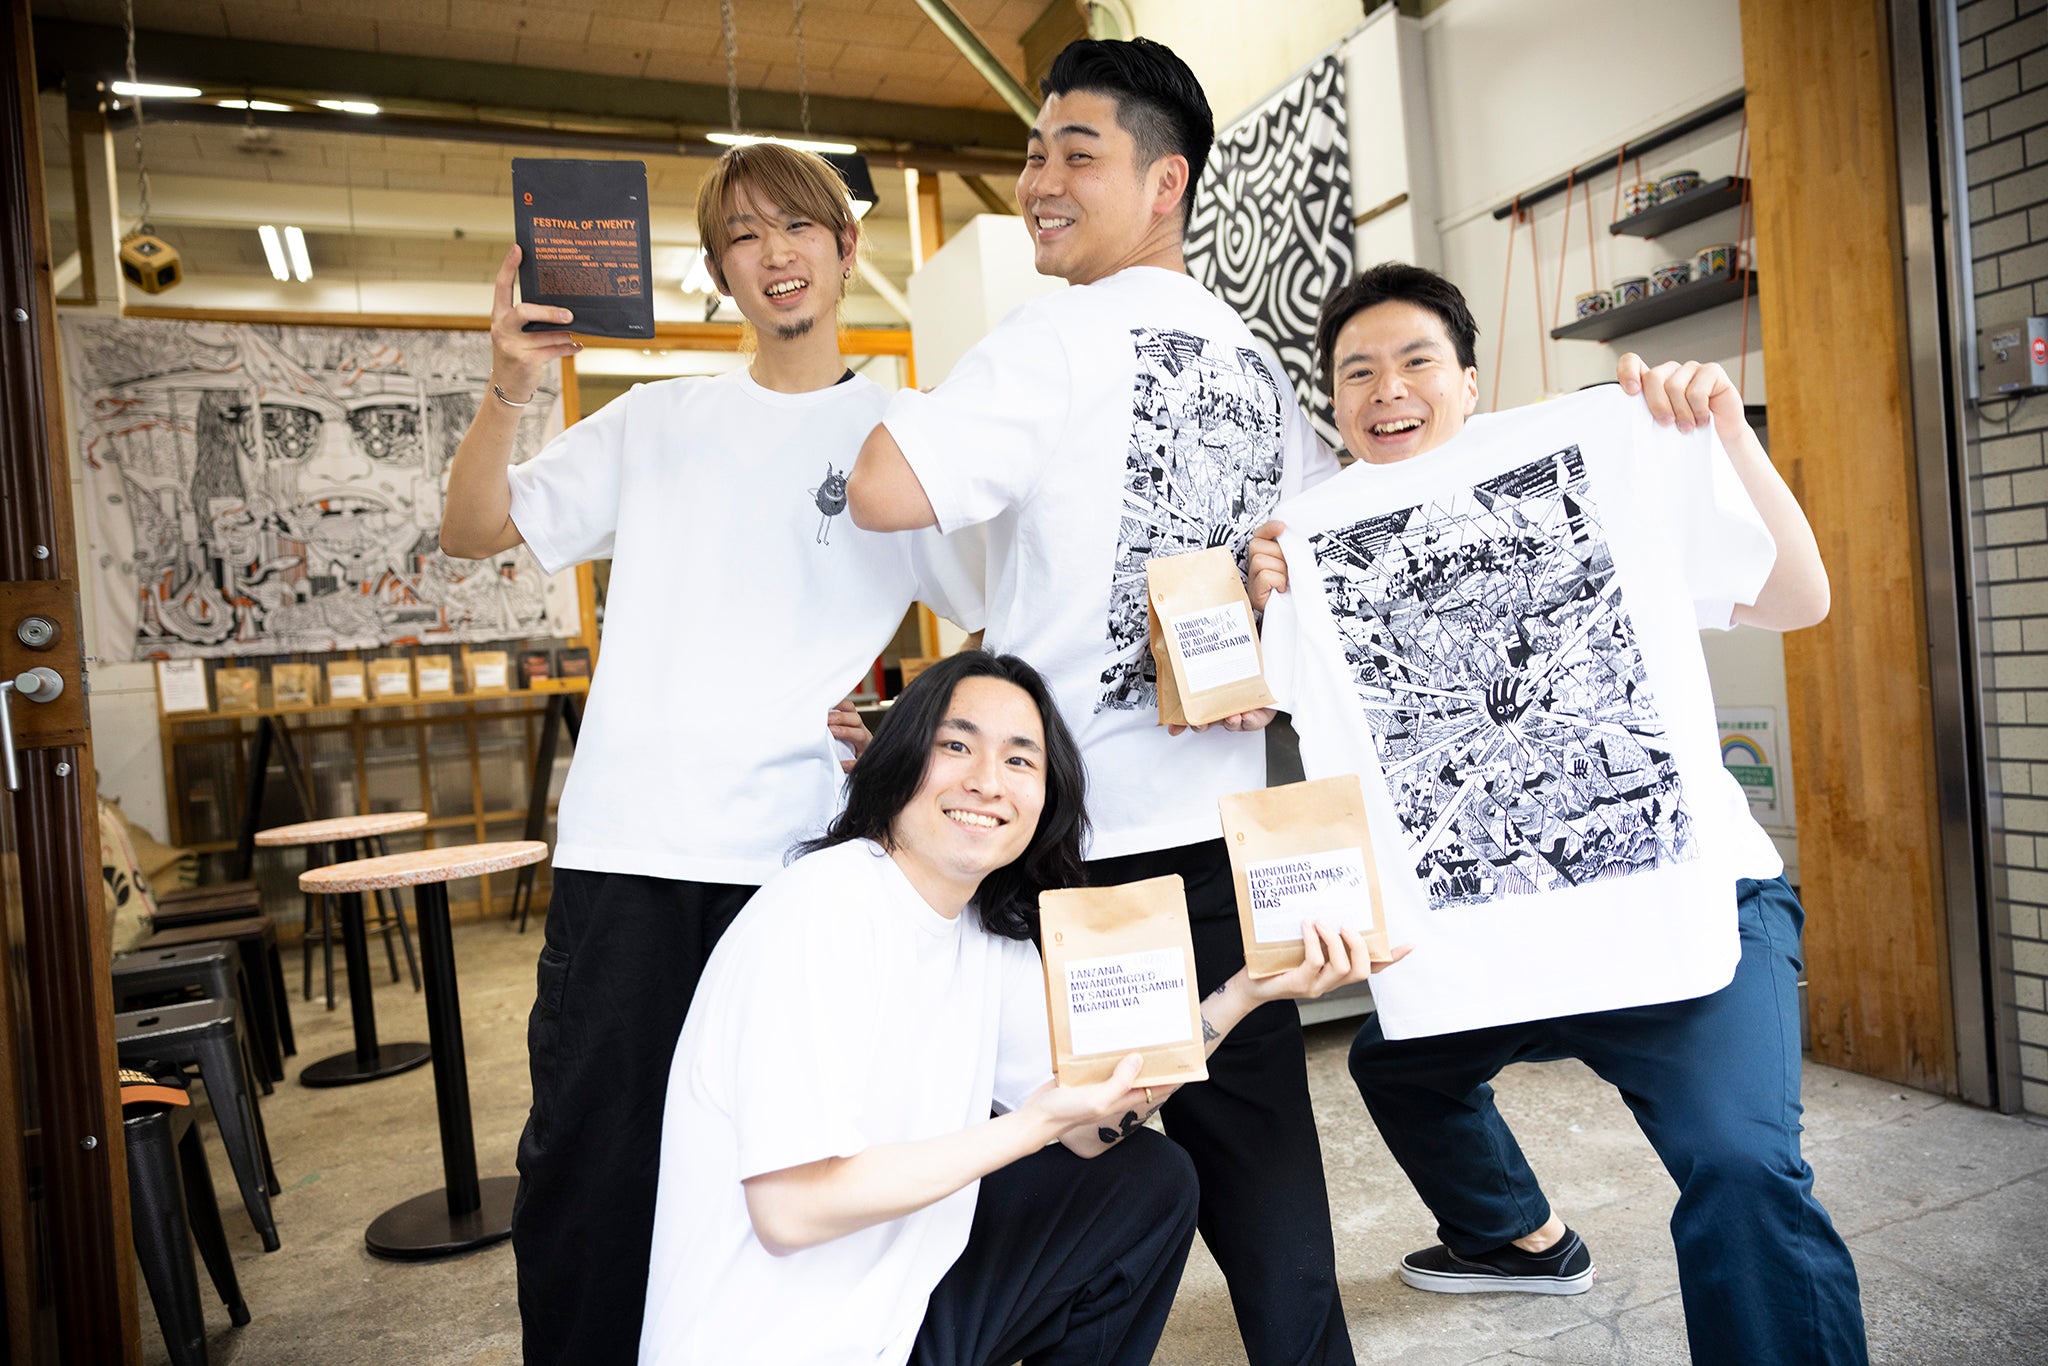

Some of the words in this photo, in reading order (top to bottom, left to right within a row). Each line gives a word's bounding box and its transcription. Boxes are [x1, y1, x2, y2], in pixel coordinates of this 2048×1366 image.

[533, 217, 579, 230] FESTIVAL
[581, 219, 595, 230] OF
[596, 219, 636, 230] TWENTY
[550, 238, 574, 246] TROPICAL
[609, 240, 638, 248] SPARKLING
[1174, 617, 1210, 631] ETHIOPIA
[1178, 629, 1204, 640] ADADO
[1180, 639, 1193, 650] BY
[1192, 633, 1219, 648] ADADO
[1182, 642, 1220, 659] WASHING
[1220, 634, 1251, 649] STATION
[1249, 861, 1312, 879] HONDURAS
[1251, 877, 1273, 890] LOS
[1275, 866, 1344, 887] ARRAYANES
[1252, 889, 1267, 900] BY
[1270, 882, 1317, 899] SANDRA
[1254, 898, 1281, 910] DIAS
[1070, 964, 1123, 980] TANZANIA
[1072, 992, 1086, 1003] BY
[1088, 986, 1126, 1001] SANGU
[1127, 978, 1184, 997] PESAMBILI
[1073, 996, 1140, 1014] MGANDILWA
